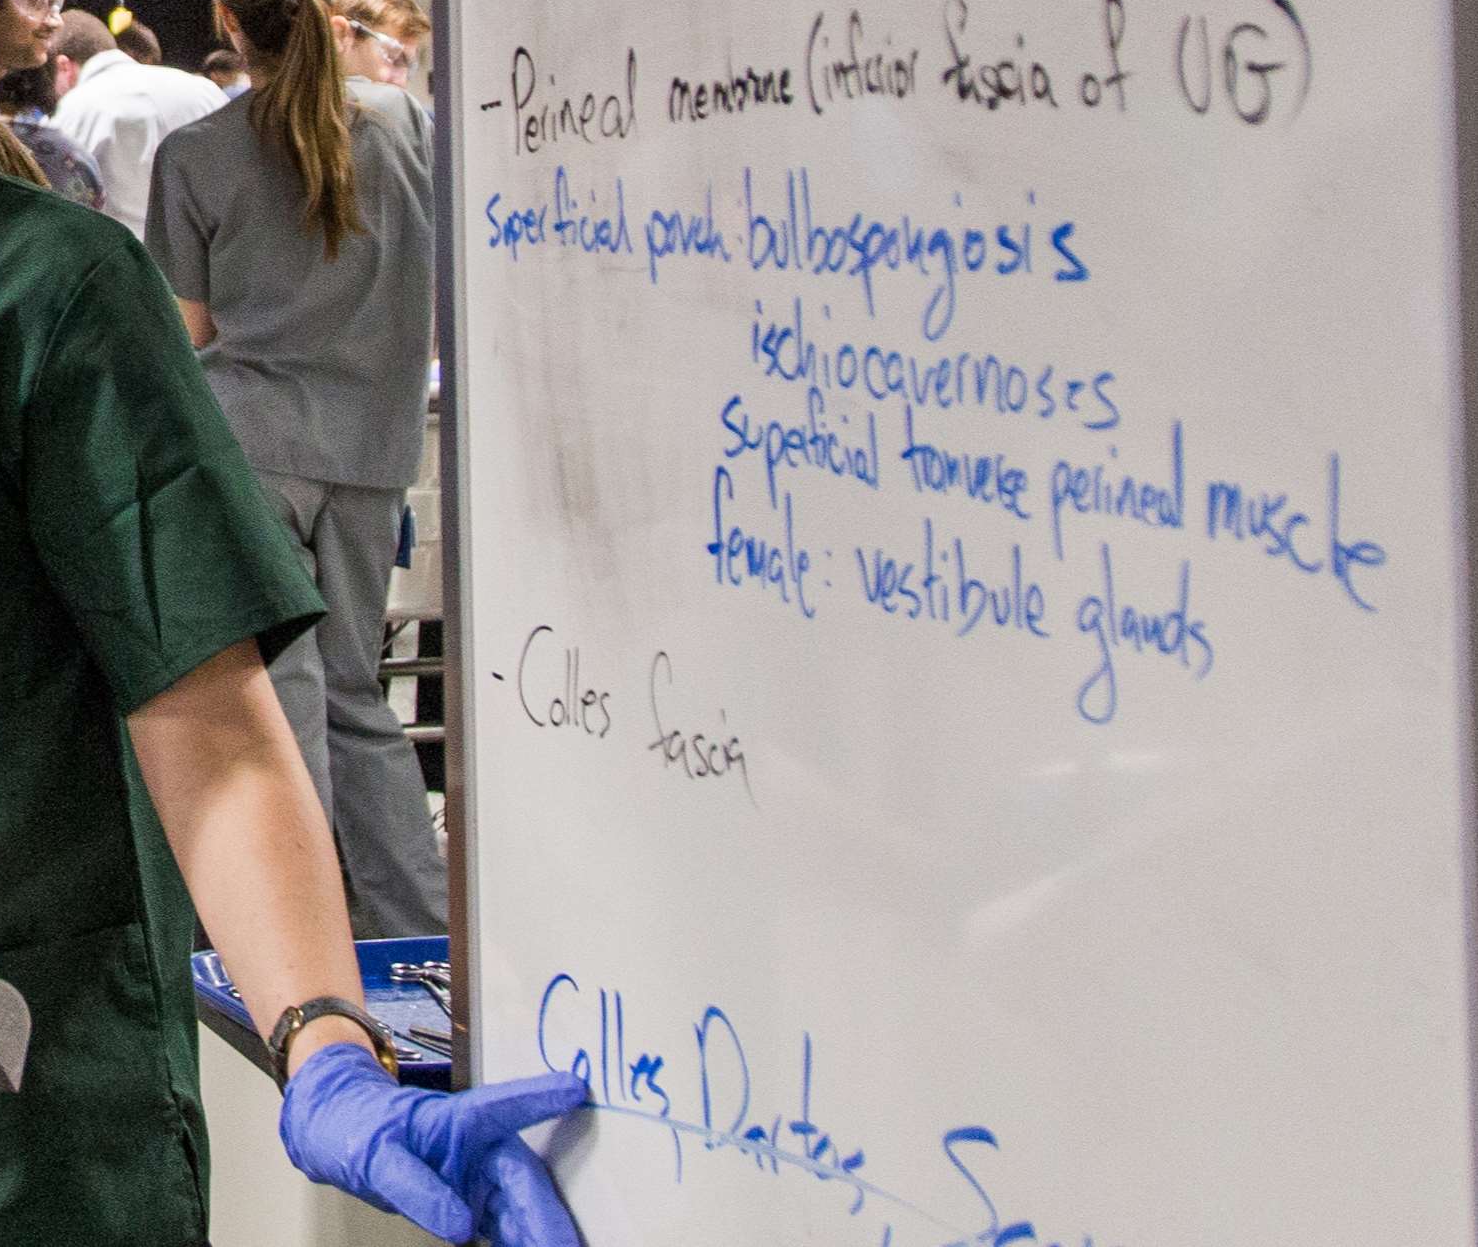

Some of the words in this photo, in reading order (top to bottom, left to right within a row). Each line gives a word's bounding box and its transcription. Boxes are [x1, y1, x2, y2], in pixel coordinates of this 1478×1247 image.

[1051, 419, 1186, 561] perineal
[1207, 451, 1387, 614] muscle
[855, 517, 1050, 637] vestibule
[1076, 542, 1215, 725] glands
[648, 650, 763, 812] fascia
